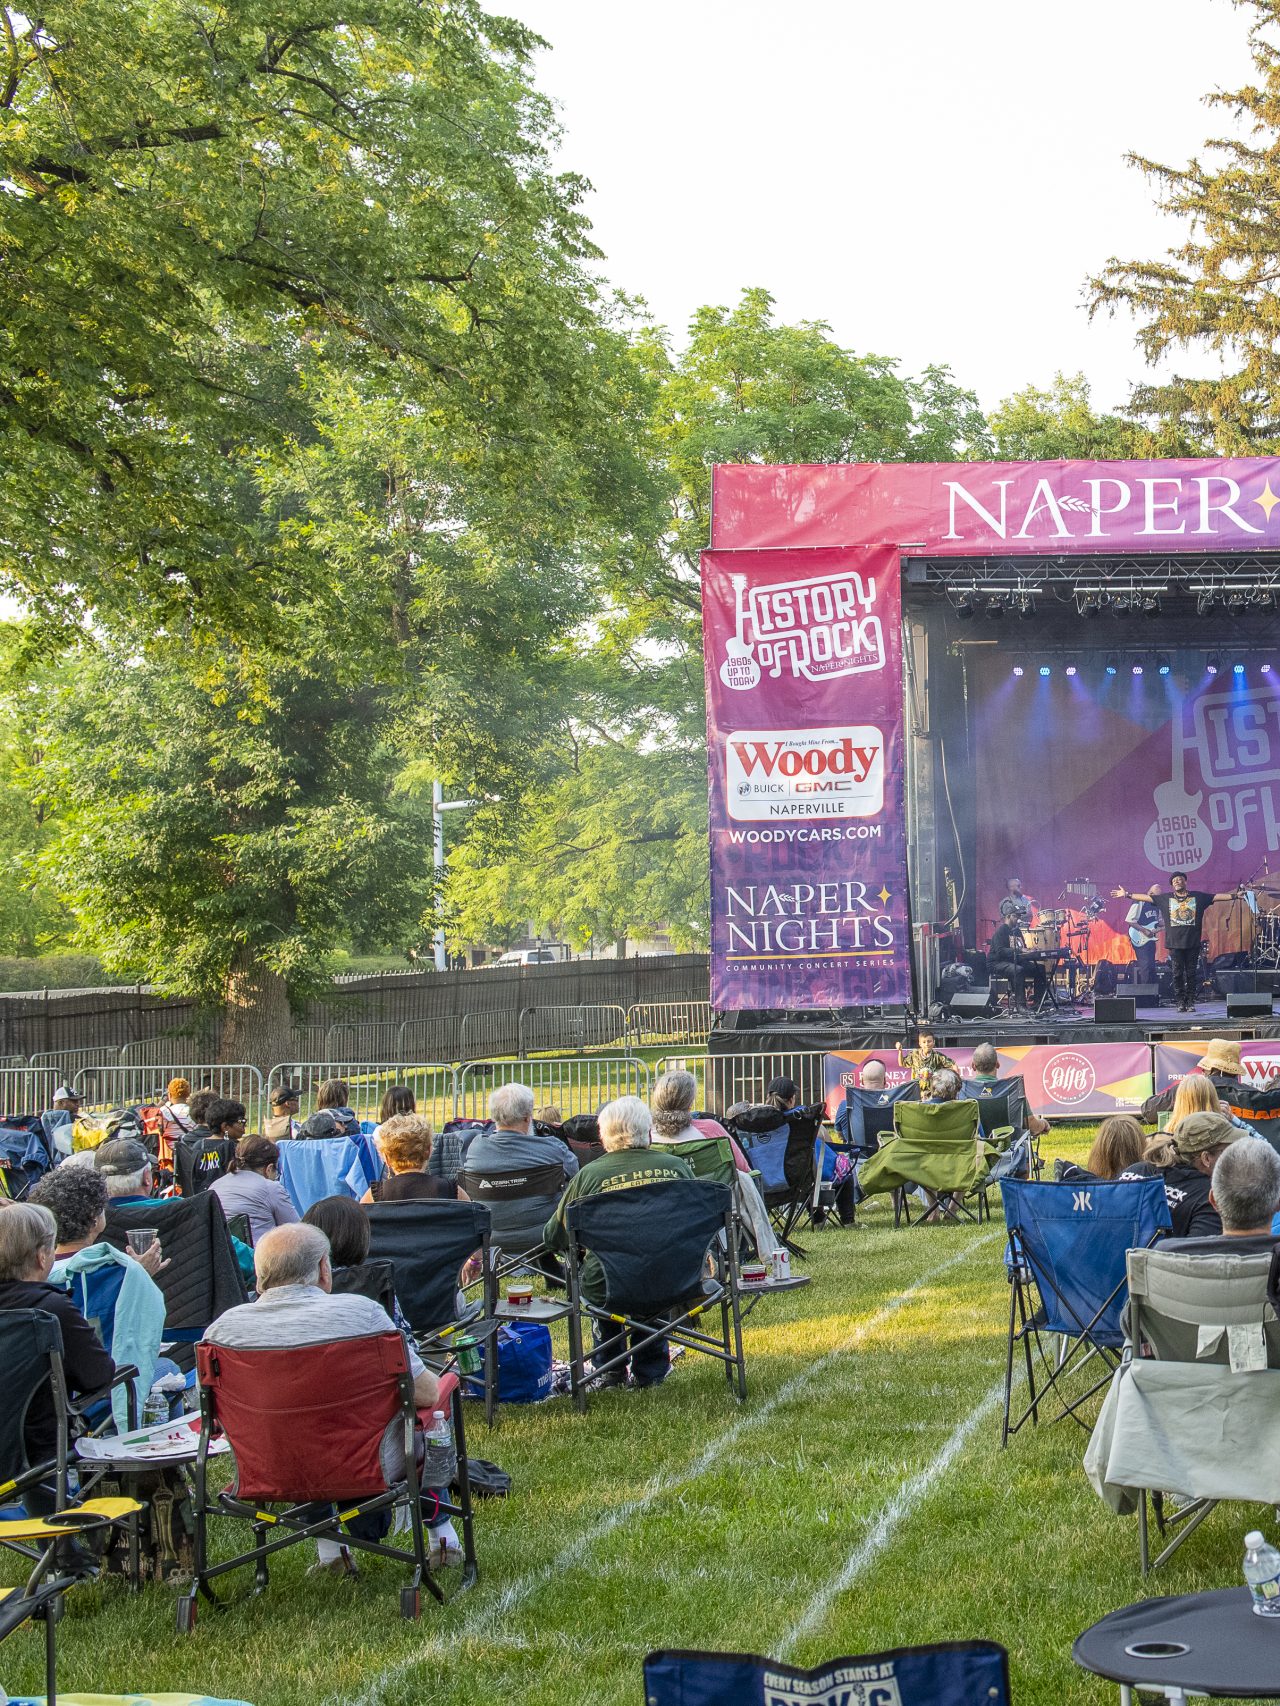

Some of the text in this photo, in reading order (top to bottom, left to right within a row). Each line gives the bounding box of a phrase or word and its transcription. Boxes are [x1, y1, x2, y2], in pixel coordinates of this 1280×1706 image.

[941, 476, 1266, 541] NAPER
[734, 571, 878, 641] HISTORY
[757, 616, 886, 682] OF ROCK
[727, 656, 752, 667] 1960s
[727, 667, 750, 676] UP TO
[728, 676, 755, 687] TODAY
[730, 738, 880, 783] Woody
[754, 780, 853, 793] BUICK GMC
[770, 802, 845, 815] NAPERVILLE
[1153, 814, 1198, 833] 1960s
[1208, 789, 1258, 851] OF
[729, 825, 882, 844] WOODYCARS.COM
[1156, 832, 1195, 849] UP TO
[1158, 847, 1202, 867] TODAY
[724, 881, 879, 917] NAPER
[725, 915, 895, 952] NIGHTS
[725, 959, 895, 972] COMMUNITY CONCERT SERIES
[601, 1173, 628, 1188] GET
[763, 1661, 895, 1696] EVERY SEASON STARTS AT
